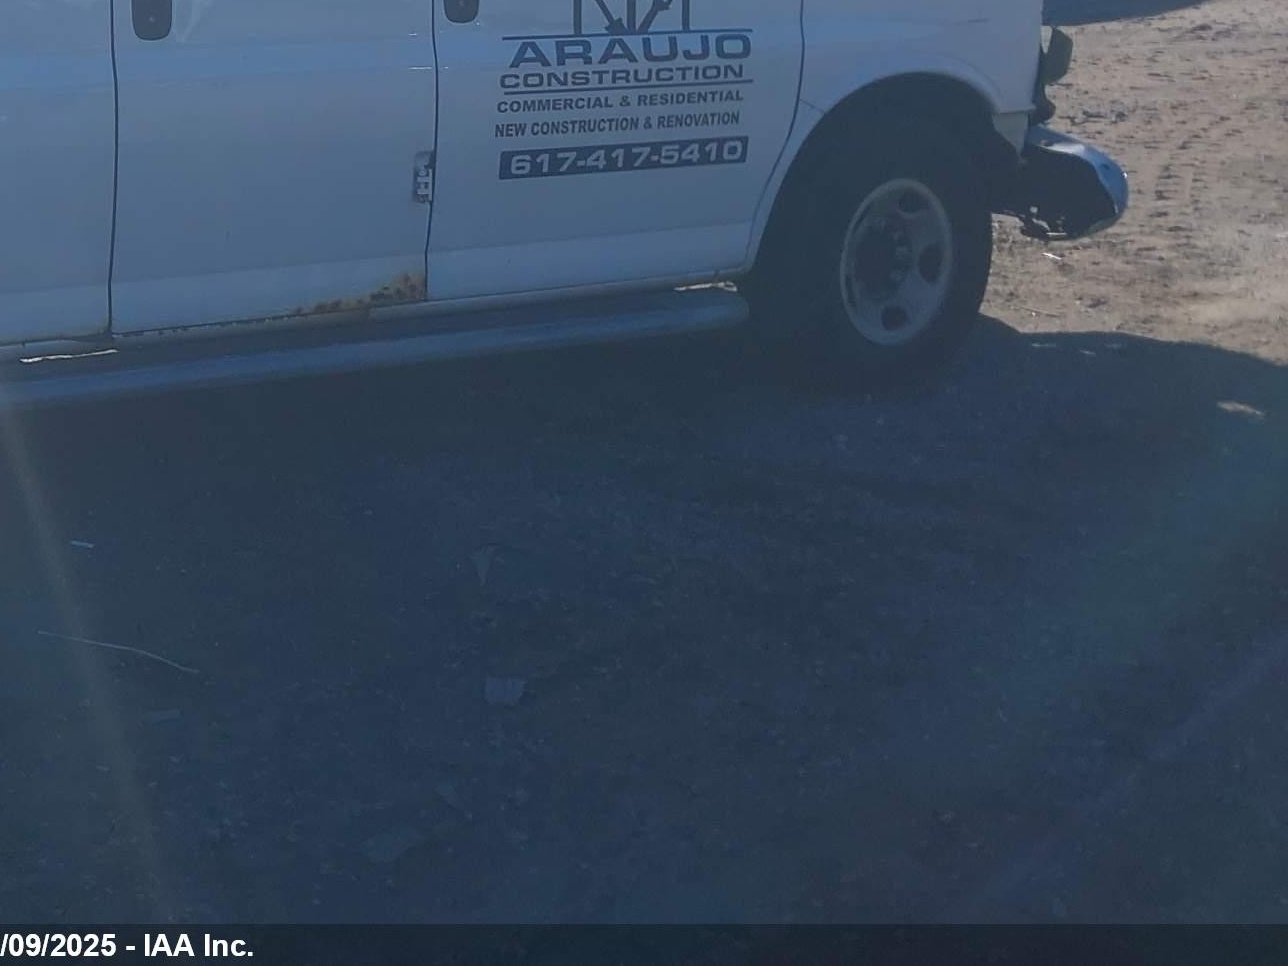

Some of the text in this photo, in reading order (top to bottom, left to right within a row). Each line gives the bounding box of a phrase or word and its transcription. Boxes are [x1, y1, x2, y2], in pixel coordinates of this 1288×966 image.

[508, 34, 752, 69] ARAUJO
[499, 64, 744, 89] CONSTRUCTION
[497, 90, 744, 114] COMMERCIAL & RESIDENTIAL
[494, 111, 740, 138] NEW CONSTRUCTION & RENOVATION
[511, 140, 743, 175] 617-417-5410
